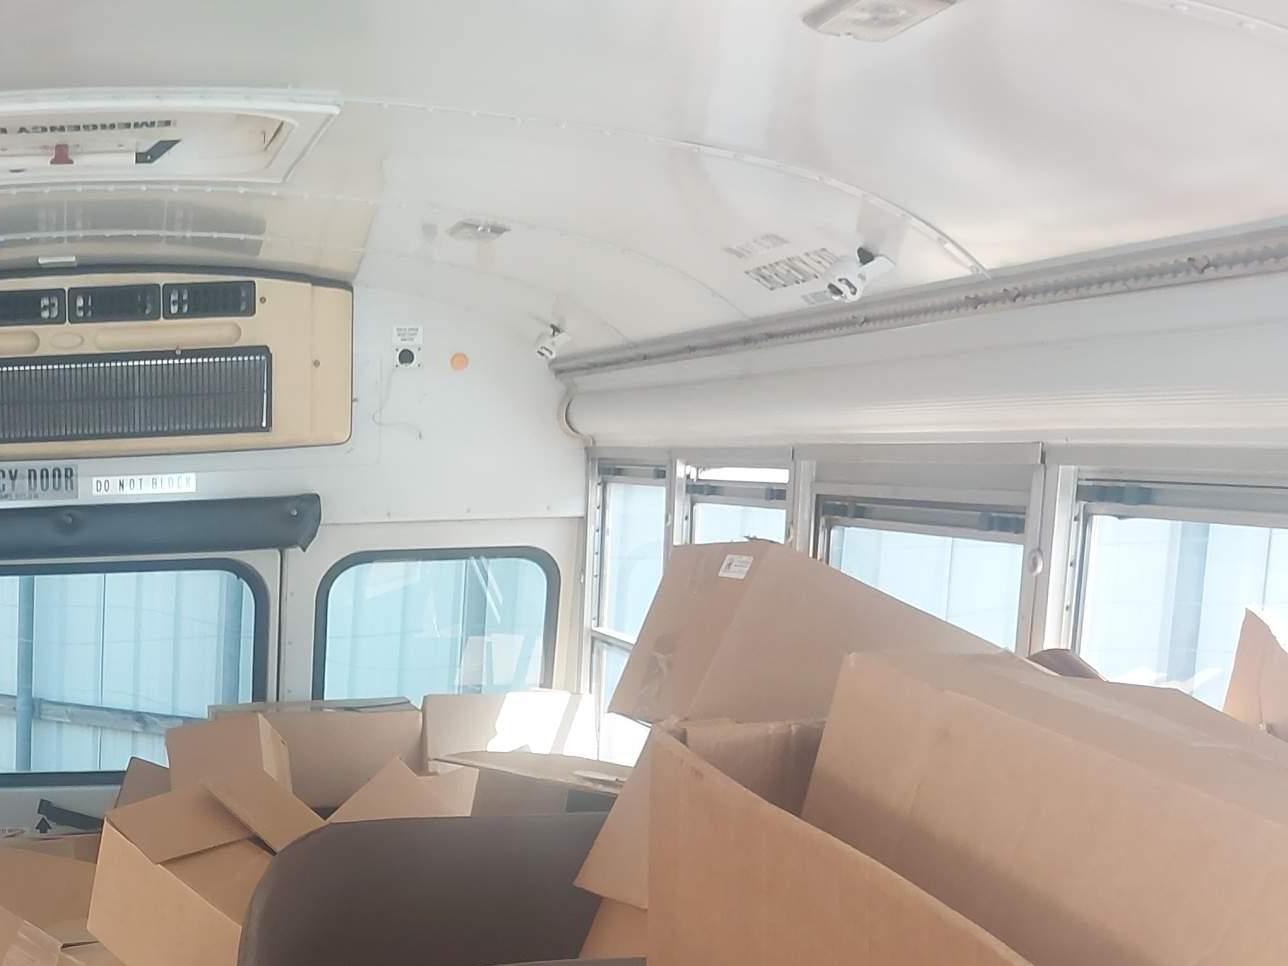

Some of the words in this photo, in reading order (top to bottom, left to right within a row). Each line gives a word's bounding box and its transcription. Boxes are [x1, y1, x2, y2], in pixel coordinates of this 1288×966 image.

[27, 466, 74, 492] DOOR
[95, 479, 110, 492] DO
[118, 478, 143, 491] NOT
